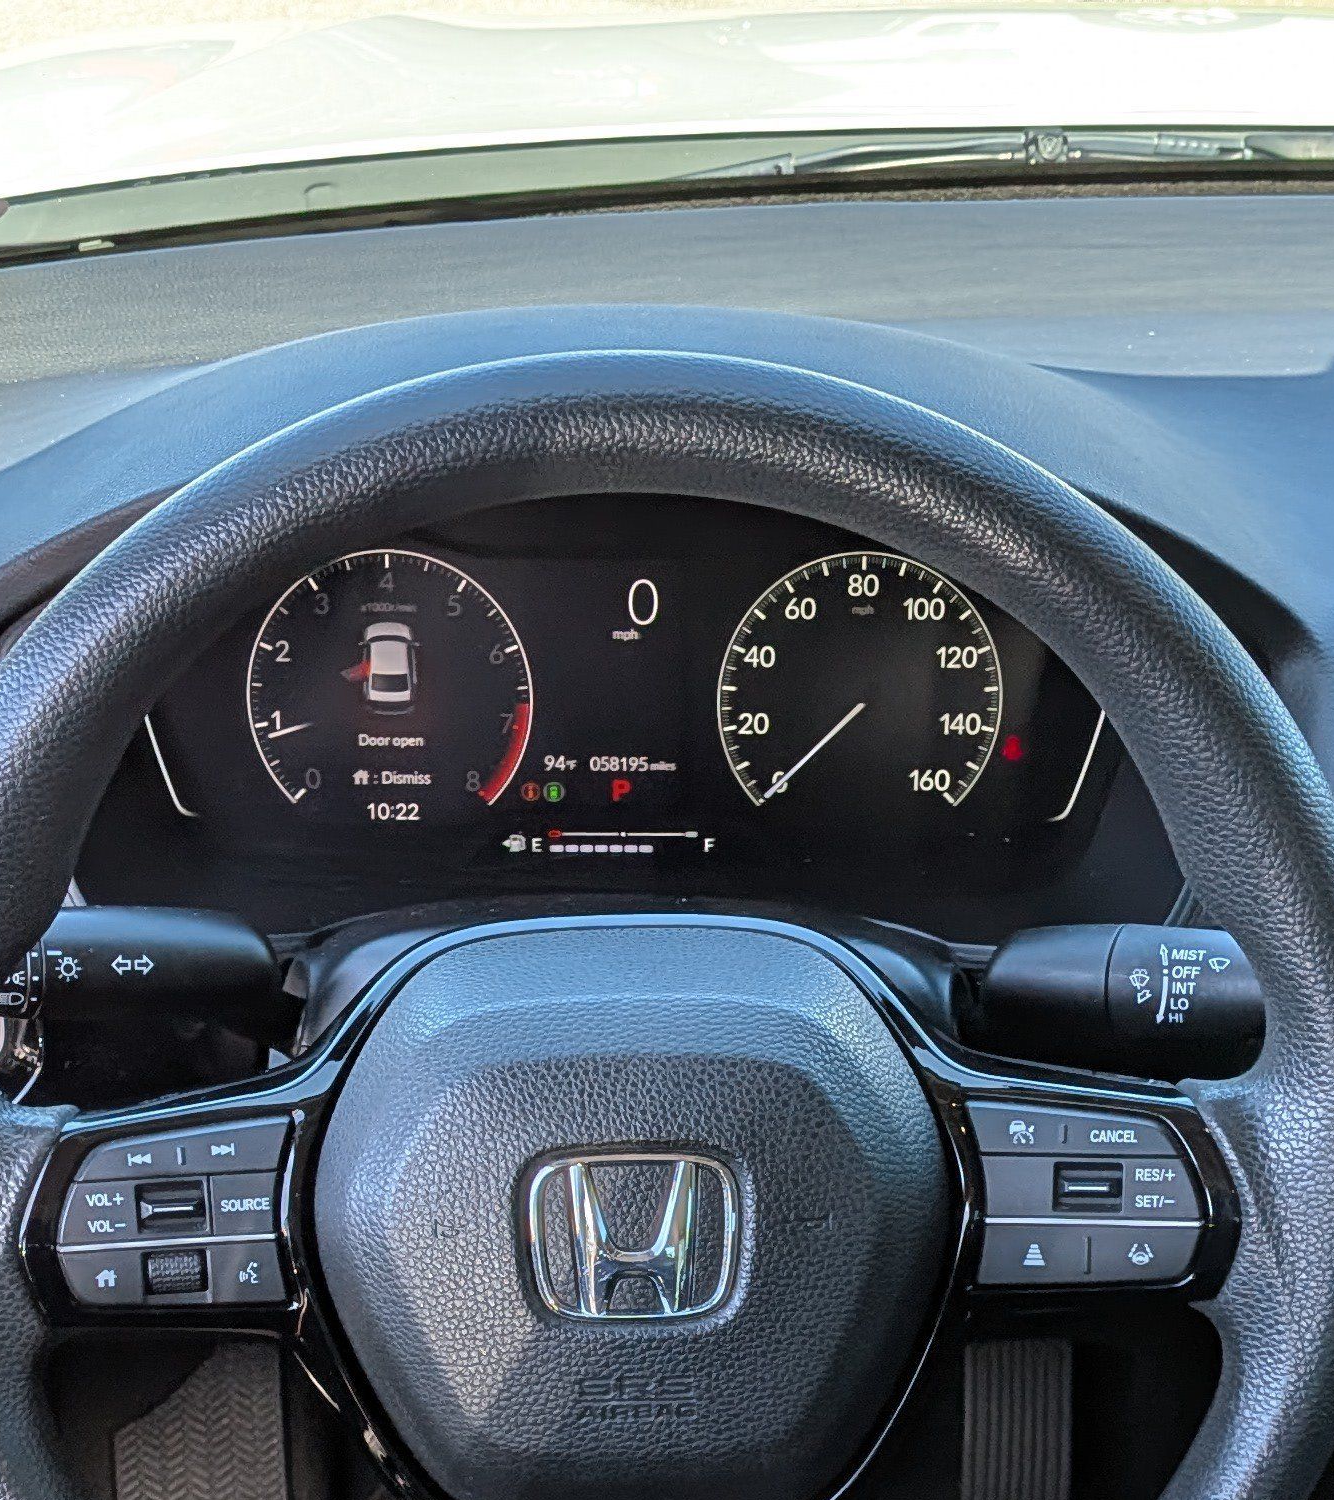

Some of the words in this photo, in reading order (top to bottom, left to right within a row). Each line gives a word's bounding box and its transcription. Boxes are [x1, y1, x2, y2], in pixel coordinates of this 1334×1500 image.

[379, 572, 394, 591] 4
[847, 574, 880, 597] 80
[315, 594, 330, 614] 3
[447, 596, 462, 616] 5
[628, 578, 659, 625] 0
[784, 597, 817, 620] 60
[903, 598, 946, 621] 100
[612, 629, 640, 641] mph
[275, 642, 292, 662] 2
[489, 645, 505, 664] 6
[744, 646, 776, 668] 40
[936, 646, 978, 669] 120
[270, 711, 282, 730] 1
[500, 713, 514, 734] 7
[737, 713, 769, 735] 20
[939, 713, 982, 735] 140
[358, 733, 390, 747] Door
[392, 736, 424, 749] open
[589, 756, 649, 771] 058195
[305, 768, 321, 789] 0
[381, 770, 432, 785] Dismiss
[466, 771, 481, 791] 8
[909, 769, 951, 792] 160
[611, 779, 632, 801] P
[367, 802, 421, 821] 10:22
[531, 837, 543, 852] E
[703, 838, 716, 852] F
[1171, 949, 1207, 962] MIST
[1172, 966, 1201, 980] OFF
[1171, 982, 1197, 996] INT
[1170, 997, 1189, 1012] LO
[1168, 1012, 1184, 1025] HI
[1090, 1129, 1138, 1144] CANCEL
[1135, 1168, 1176, 1183] RES/+
[220, 1197, 270, 1213] SOURCE
